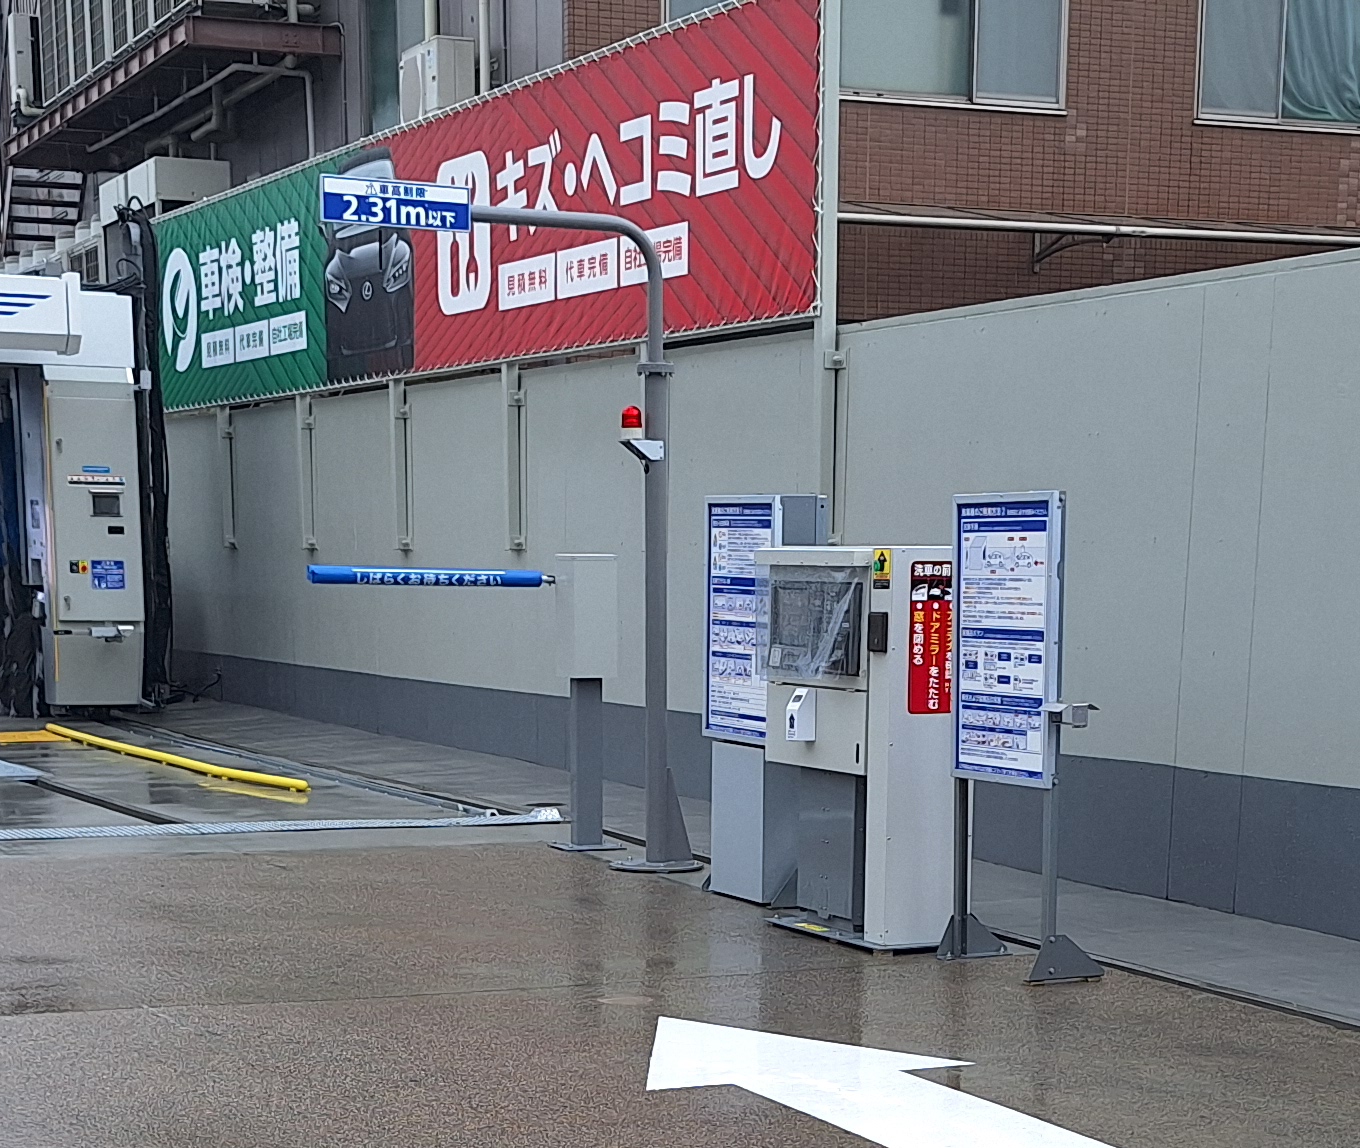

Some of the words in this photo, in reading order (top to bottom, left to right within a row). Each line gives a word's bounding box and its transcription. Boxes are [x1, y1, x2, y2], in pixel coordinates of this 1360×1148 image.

[495, 73, 783, 242] キズ・ヘコミ直し
[379, 184, 426, 199] 車高制限
[342, 195, 456, 228] 2.31m以下
[199, 217, 301, 320] 車検・整備
[566, 252, 609, 284] 代車完備
[356, 572, 502, 586] しばらくお待ちください
[927, 611, 941, 710] ドアミラーをたたむ
